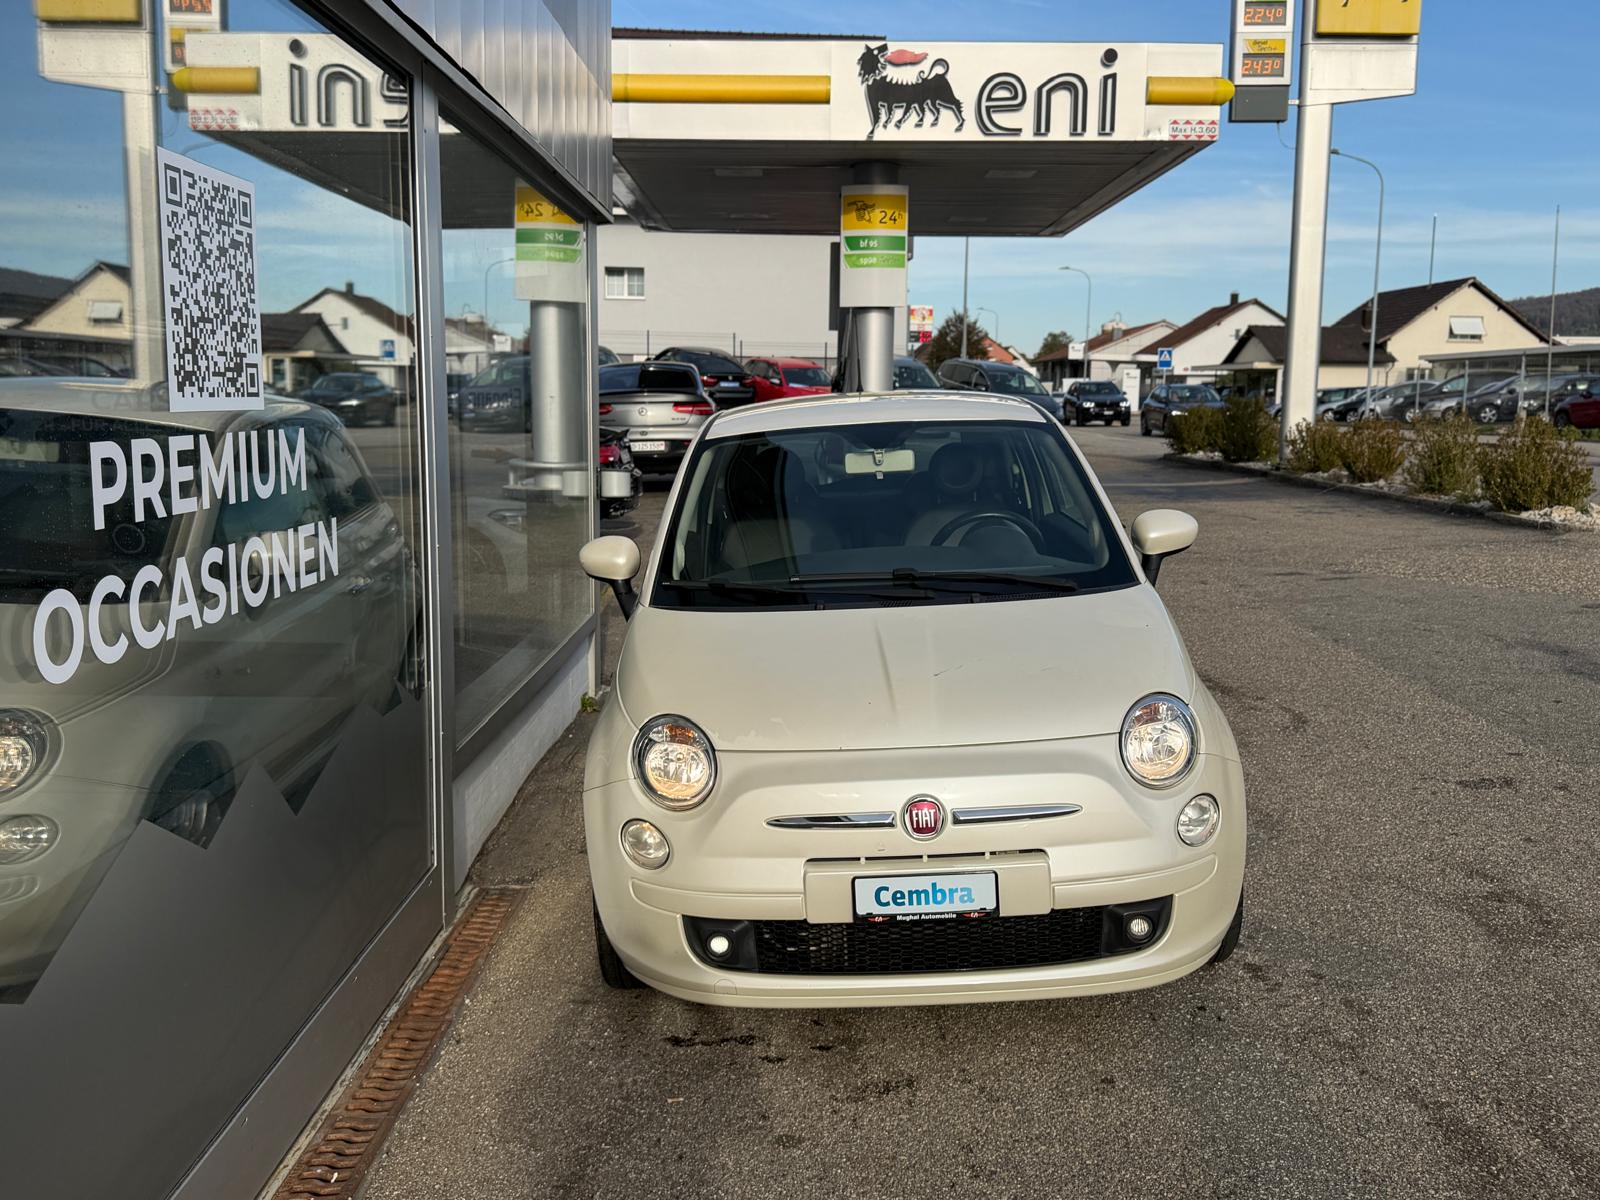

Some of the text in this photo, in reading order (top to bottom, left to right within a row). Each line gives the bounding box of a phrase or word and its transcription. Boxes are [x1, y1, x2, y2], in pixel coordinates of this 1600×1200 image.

[975, 47, 1118, 137] eni
[89, 427, 308, 531] PREMIUM
[33, 516, 339, 685] OCCASIONEN
[912, 808, 936, 829] FIAT
[874, 882, 975, 907] Cembra
[896, 912, 957, 922] Mughal Automobile
